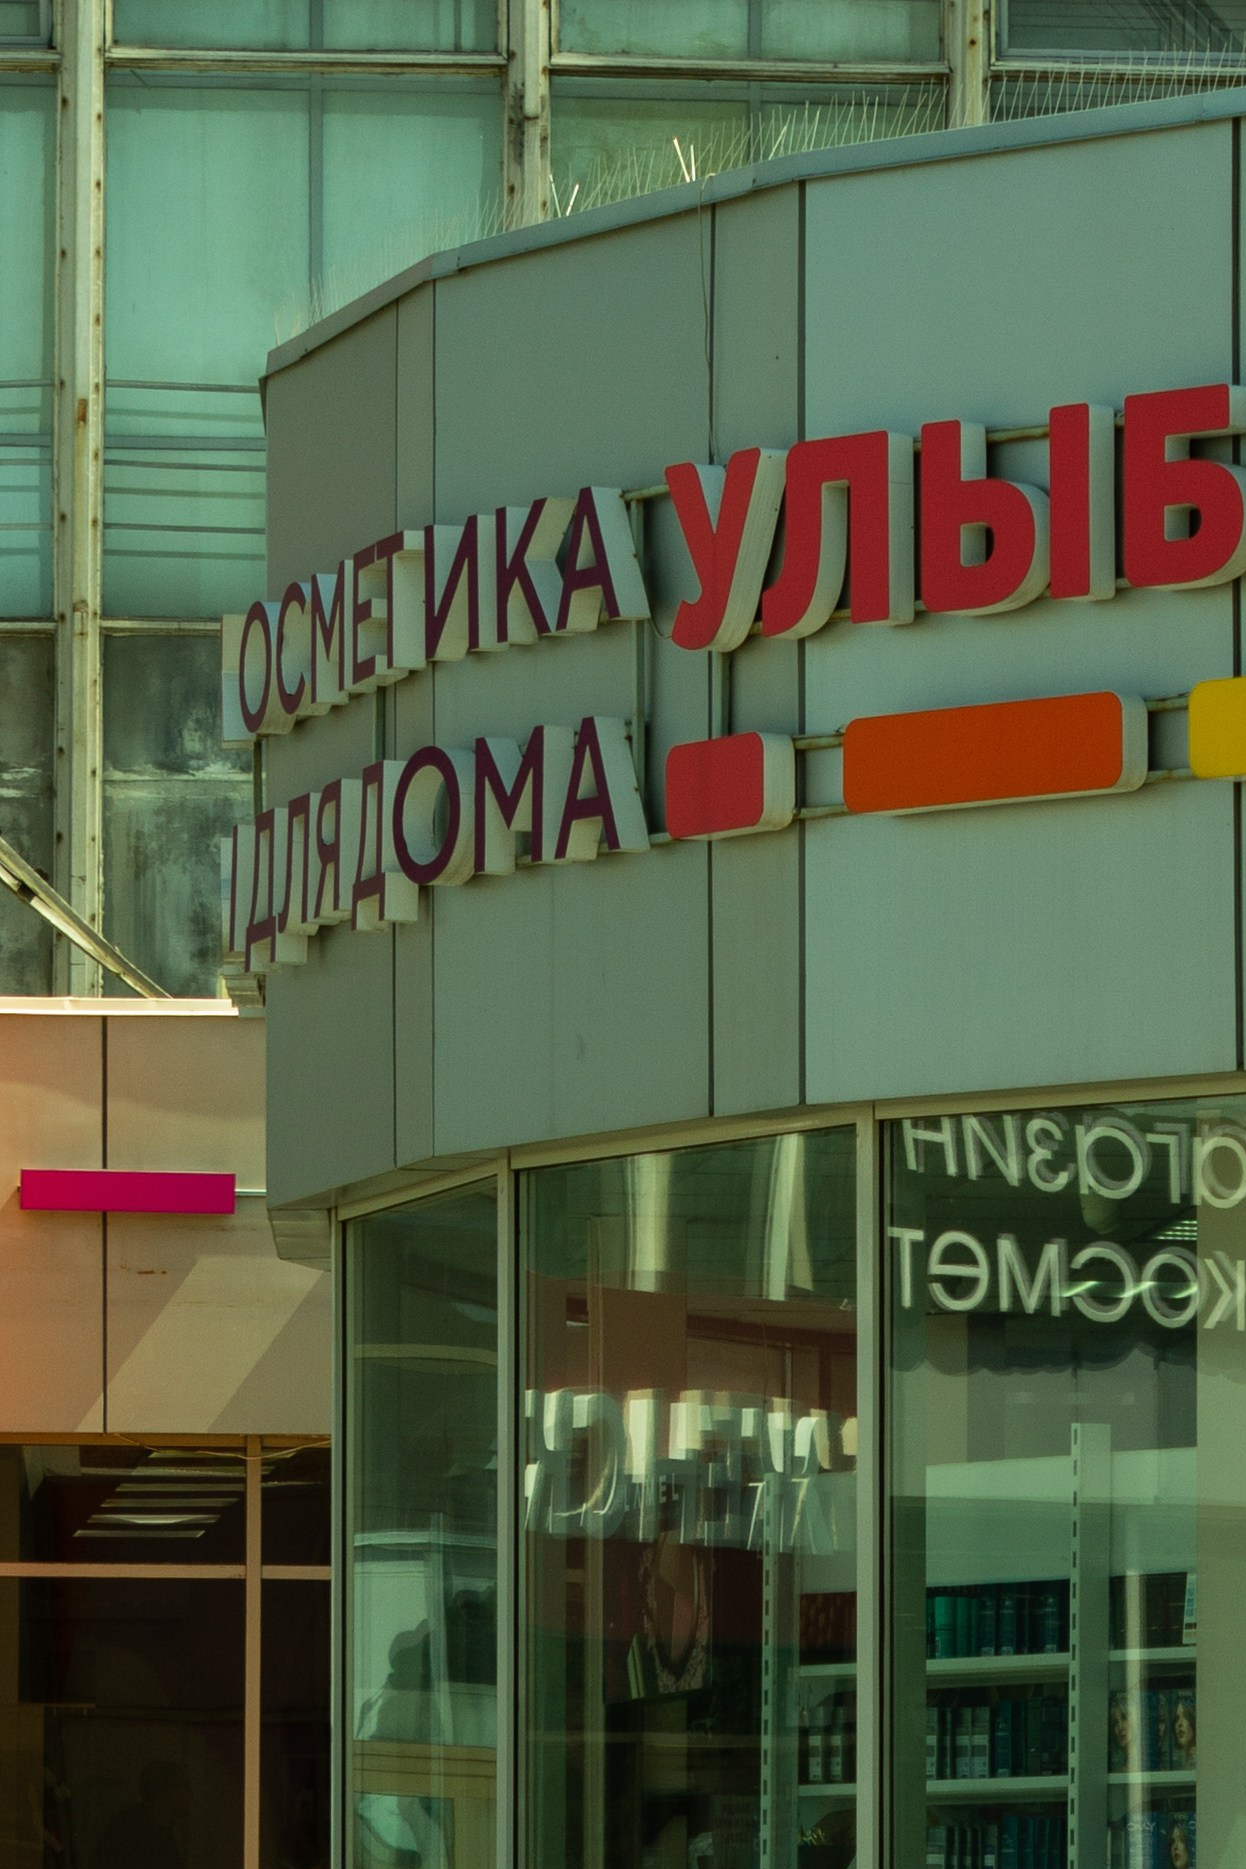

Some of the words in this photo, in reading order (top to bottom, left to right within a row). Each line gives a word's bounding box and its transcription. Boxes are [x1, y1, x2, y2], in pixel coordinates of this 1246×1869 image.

[239, 486, 624, 734] ОСМЕТИКА
[244, 776, 342, 973] ДЛЯ
[351, 716, 622, 932] ДОМА
